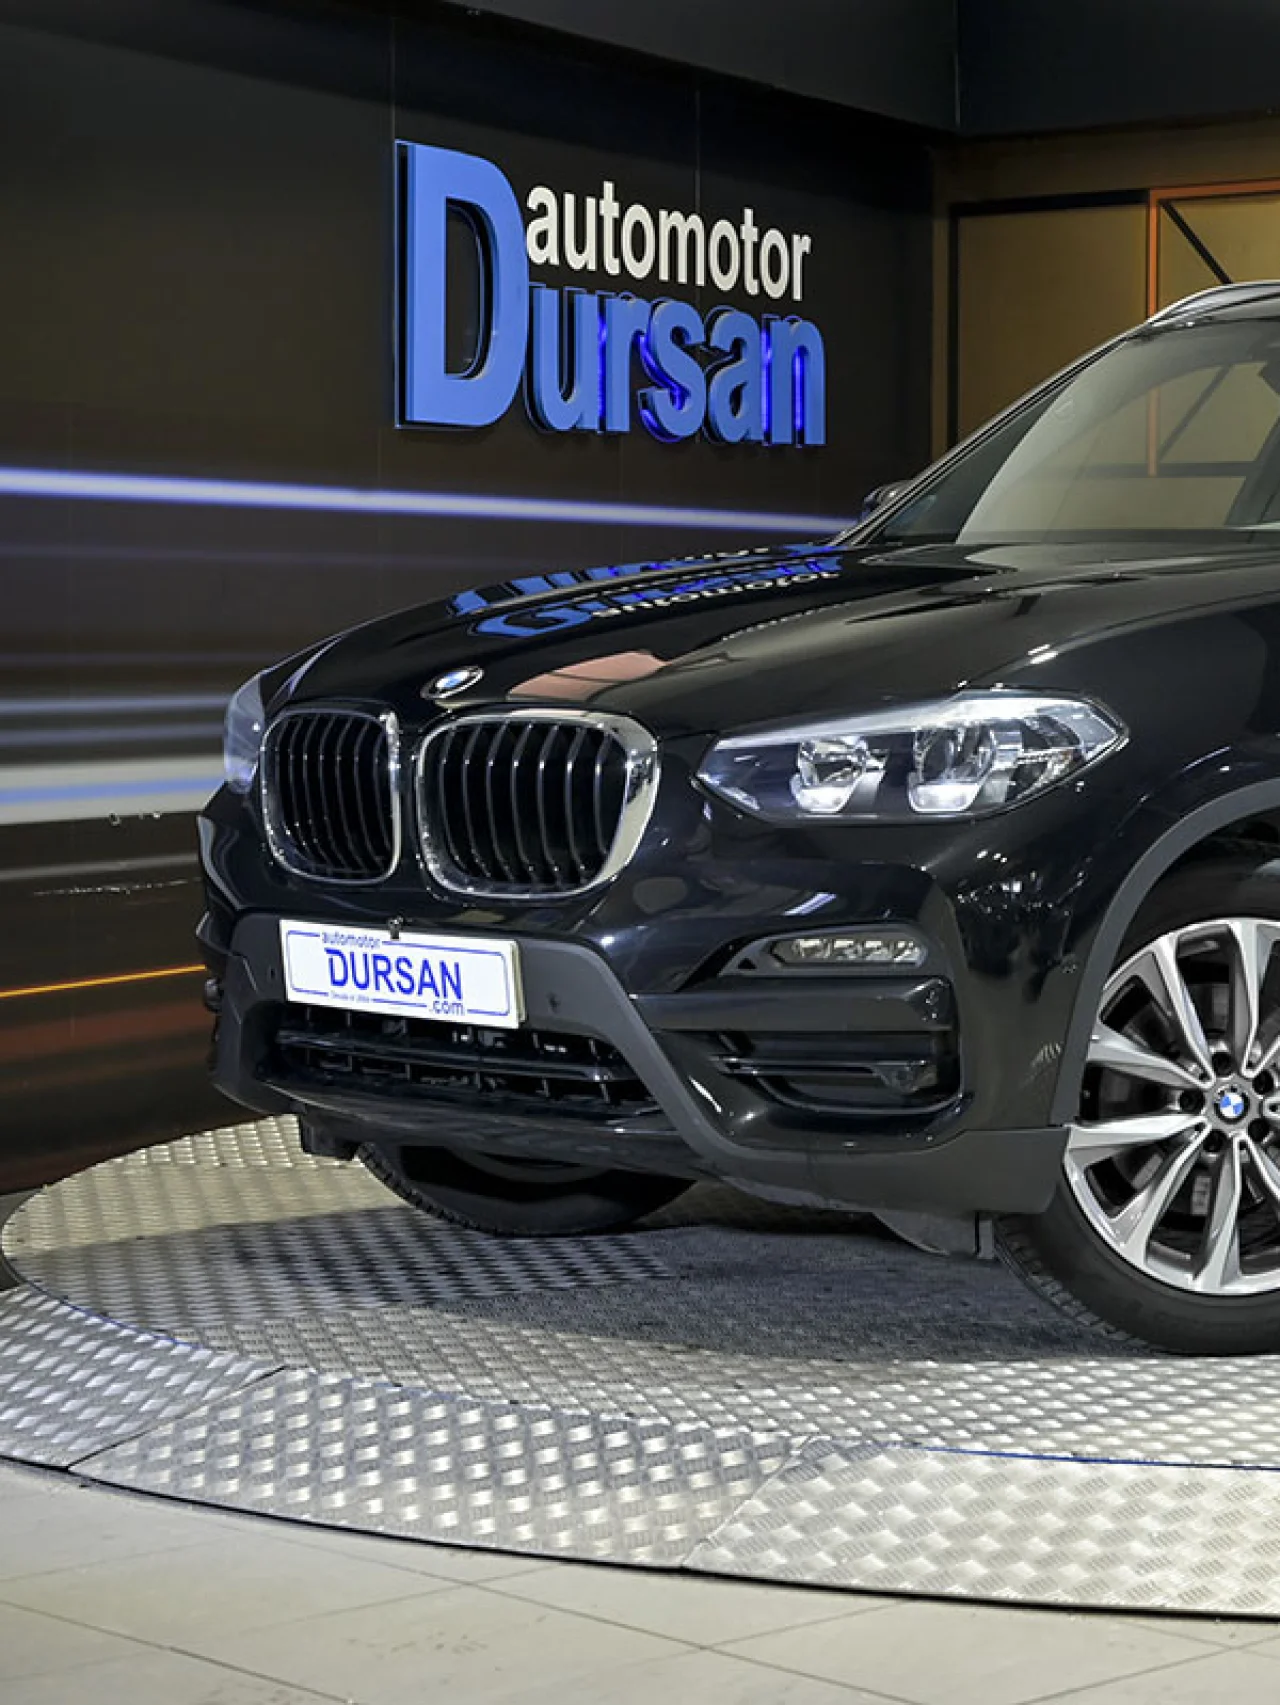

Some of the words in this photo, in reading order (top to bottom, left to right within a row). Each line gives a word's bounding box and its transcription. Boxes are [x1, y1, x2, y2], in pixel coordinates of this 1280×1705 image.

[394, 139, 827, 447] Dursan
[525, 180, 812, 301] automotor
[324, 947, 463, 1000] DURSAN
